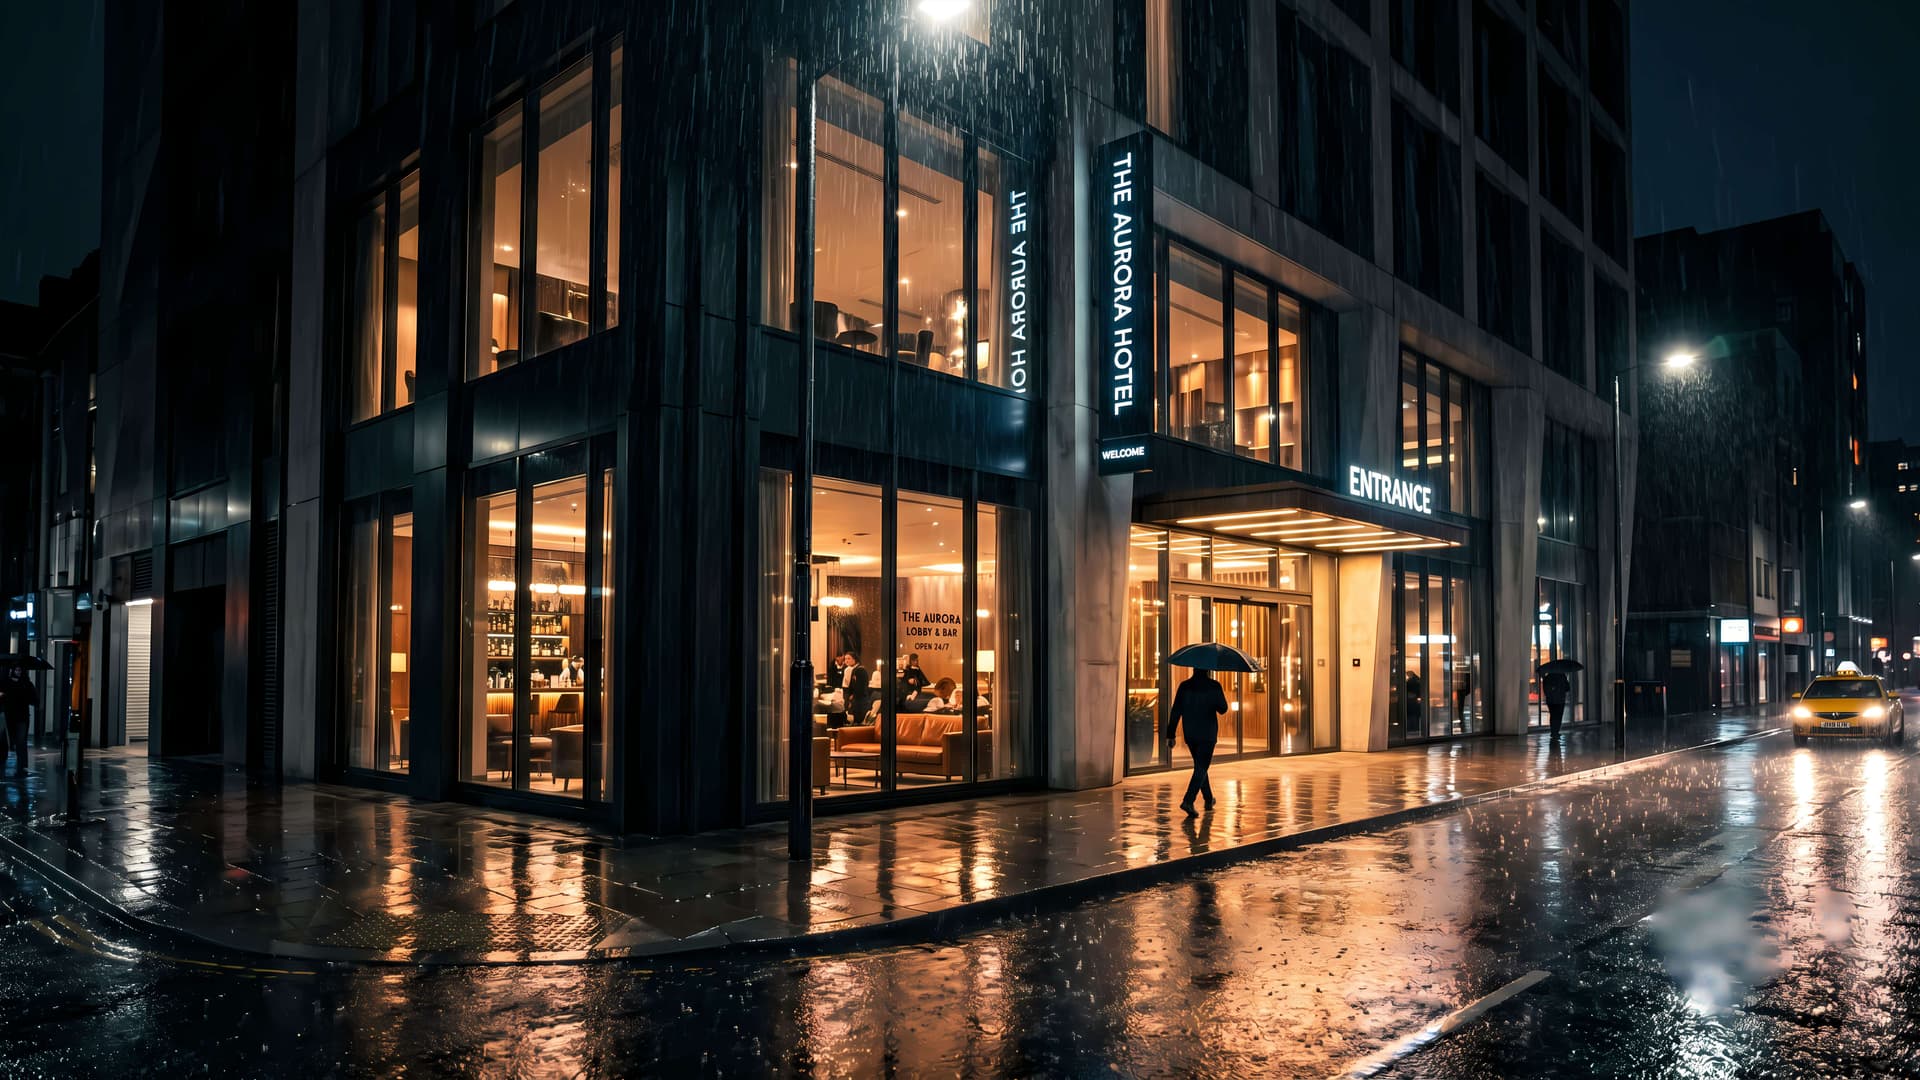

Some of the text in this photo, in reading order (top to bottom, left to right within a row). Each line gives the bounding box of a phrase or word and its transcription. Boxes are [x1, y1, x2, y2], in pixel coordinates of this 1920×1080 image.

[1113, 151, 1133, 416] THE AURORA HOTEL
[1101, 446, 1145, 460] WELCOME
[1349, 465, 1432, 515] ENTRANCE
[902, 611, 961, 624] THE AURORA
[906, 627, 957, 637] LOBBY & BAR
[934, 643, 949, 651] 24/7
